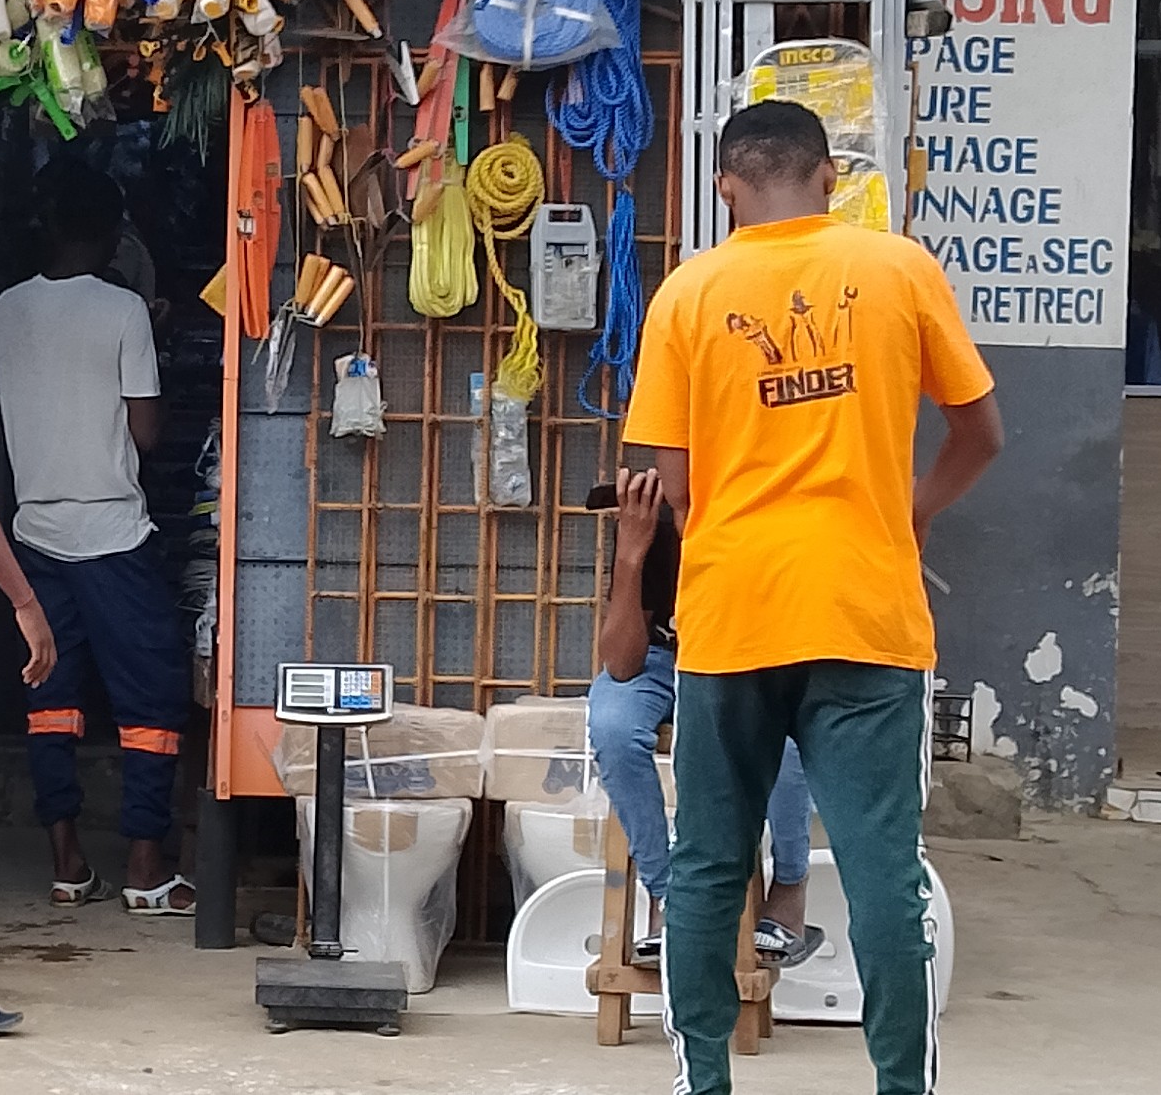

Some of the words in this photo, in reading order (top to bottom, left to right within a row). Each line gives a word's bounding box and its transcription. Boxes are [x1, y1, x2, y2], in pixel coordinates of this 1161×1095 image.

[904, 85, 992, 124] URE
[917, 235, 1023, 274] YAGE
[1042, 238, 1114, 276] SEC
[971, 285, 1105, 325] RETRECI
